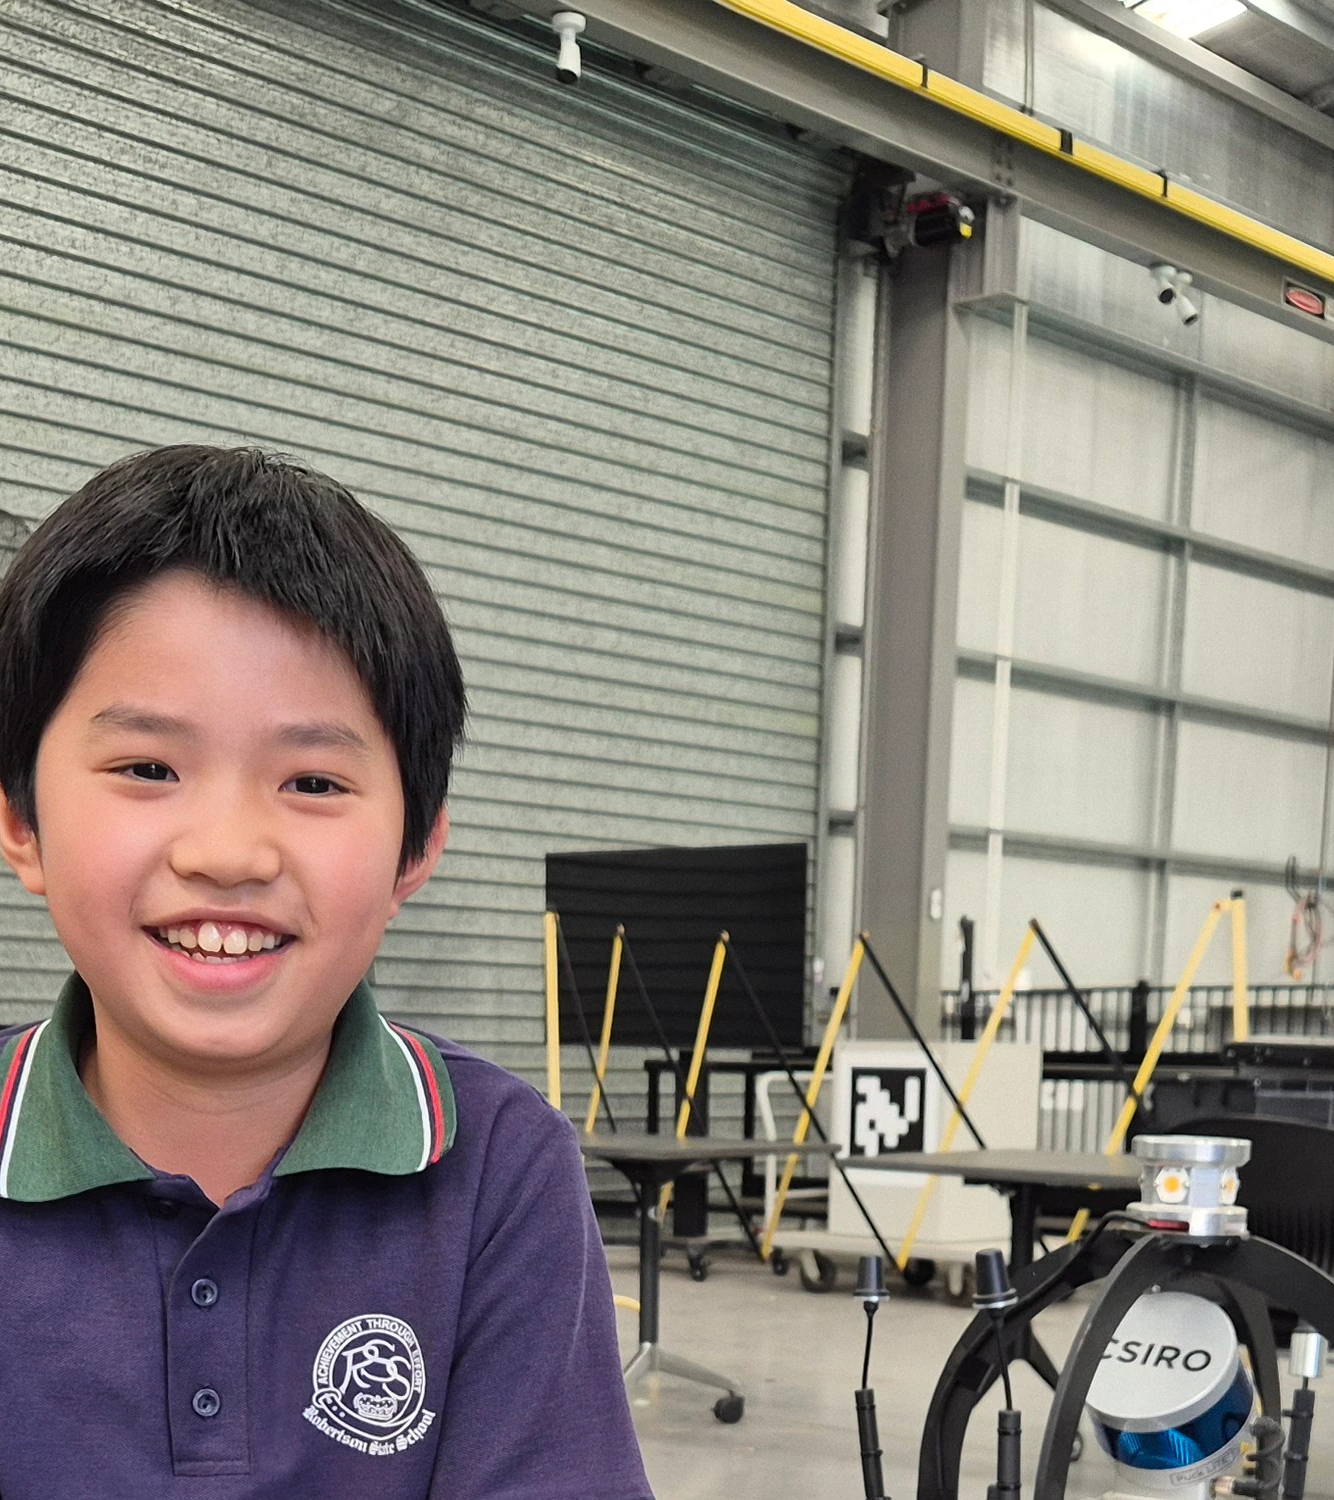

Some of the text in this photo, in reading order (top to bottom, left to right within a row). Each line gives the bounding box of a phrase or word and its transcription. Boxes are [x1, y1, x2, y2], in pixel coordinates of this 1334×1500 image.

[317, 1318, 423, 1394] ACHIEVEMENT THROUGH EFFORT
[302, 1404, 368, 1453] Robertson
[396, 1408, 436, 1452] School
